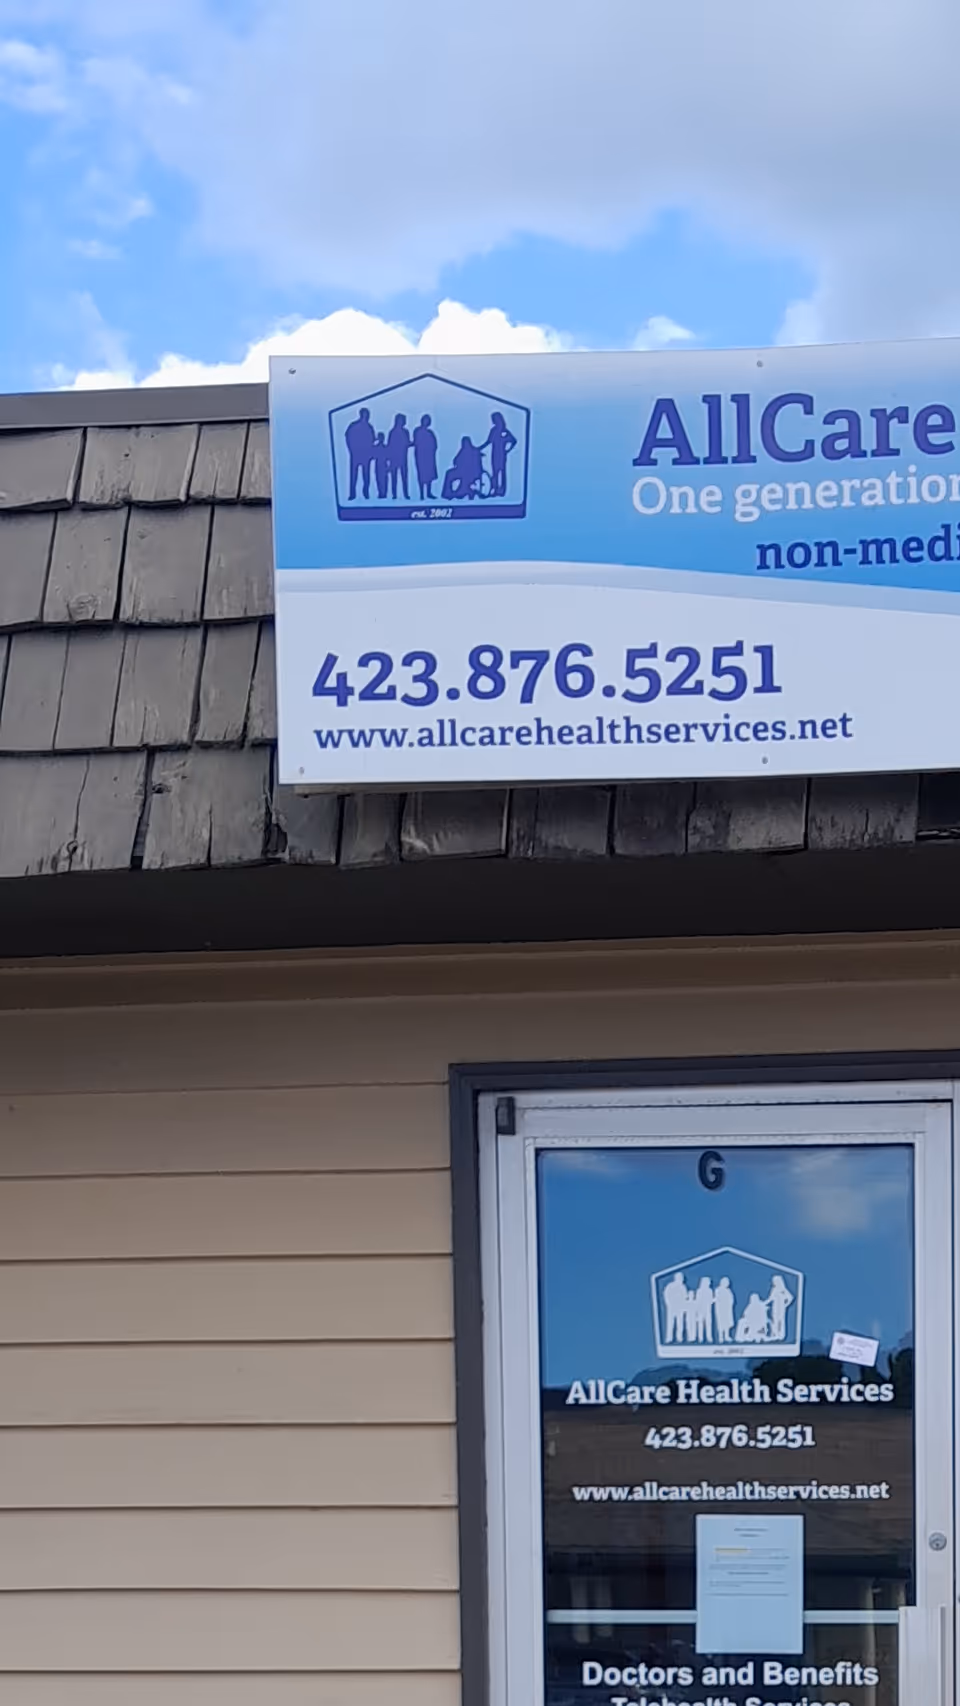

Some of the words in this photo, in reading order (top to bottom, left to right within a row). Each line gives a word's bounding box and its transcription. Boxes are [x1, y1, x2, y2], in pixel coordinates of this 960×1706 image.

[632, 391, 956, 467] AllCare
[632, 477, 722, 516] One
[311, 639, 783, 707] 423.876.5251
[313, 711, 854, 749] www.allcarehealthservices.net
[698, 1150, 726, 1191] G
[566, 1379, 671, 1405] AllCare
[677, 1378, 770, 1404] Health
[776, 1377, 894, 1403] Services
[644, 1425, 815, 1449] 423.876.5251
[572, 1481, 890, 1502] www.allcarehealthservices.net
[582, 1662, 694, 1686] Doctors
[701, 1661, 754, 1686] and
[763, 1661, 879, 1686] Benefits
